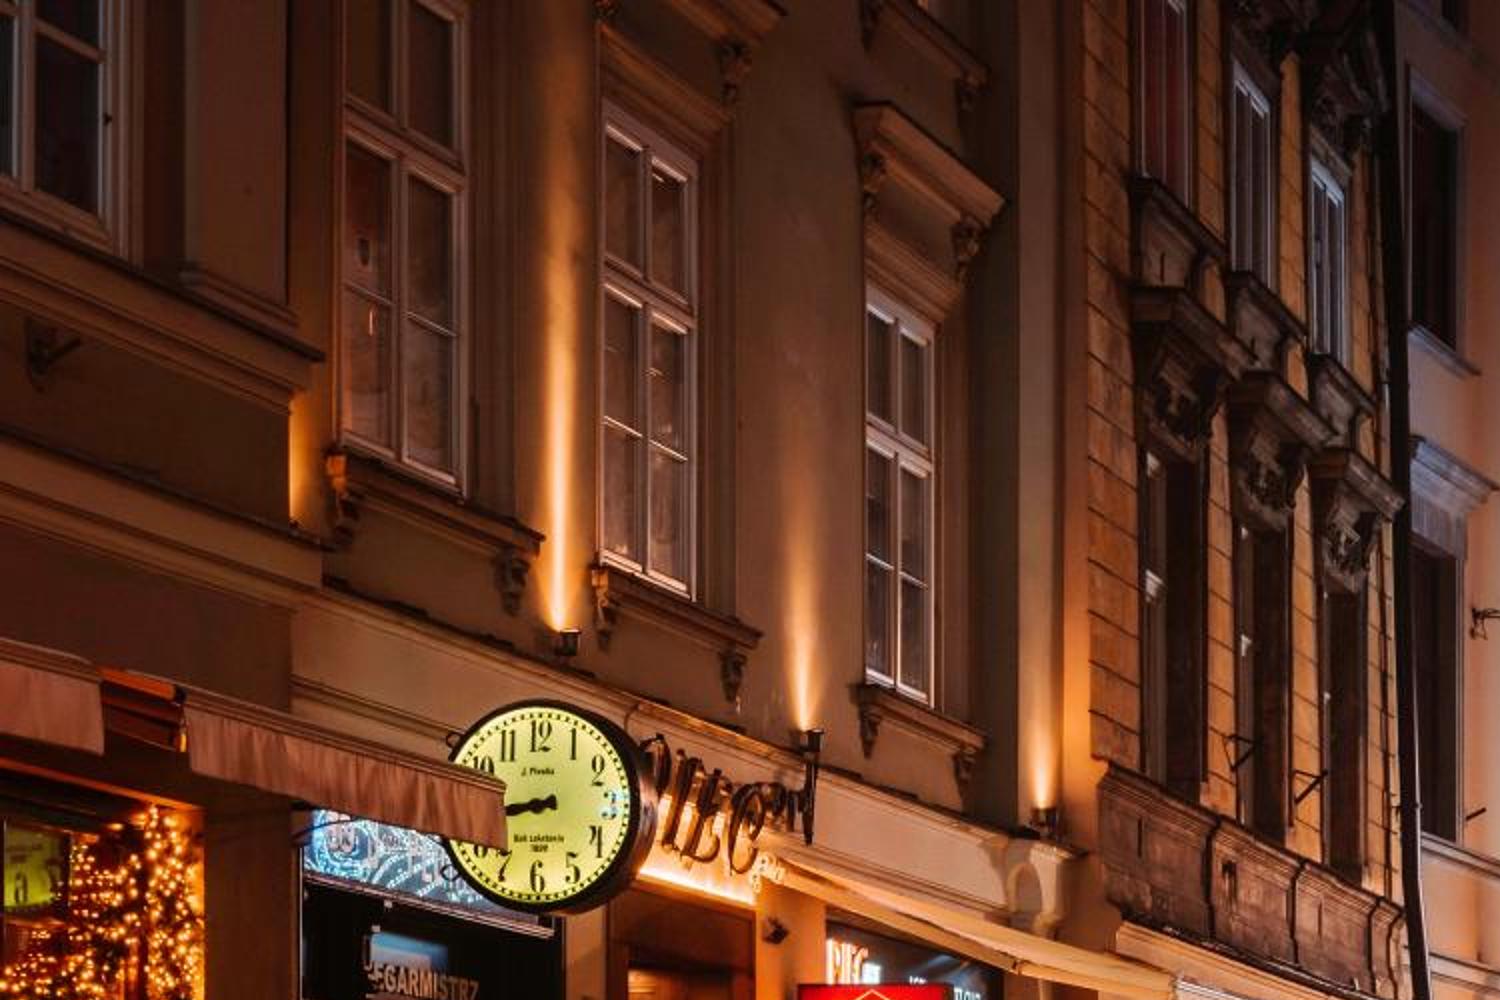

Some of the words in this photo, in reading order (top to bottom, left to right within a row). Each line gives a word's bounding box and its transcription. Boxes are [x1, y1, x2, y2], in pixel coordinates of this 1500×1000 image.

[500, 729, 516, 762] 11
[529, 720, 552, 752] 12
[570, 727, 577, 760] 1
[591, 754, 605, 786] 2
[589, 825, 603, 858] 4
[530, 860, 545, 893] 6
[565, 852, 580, 884] 5
